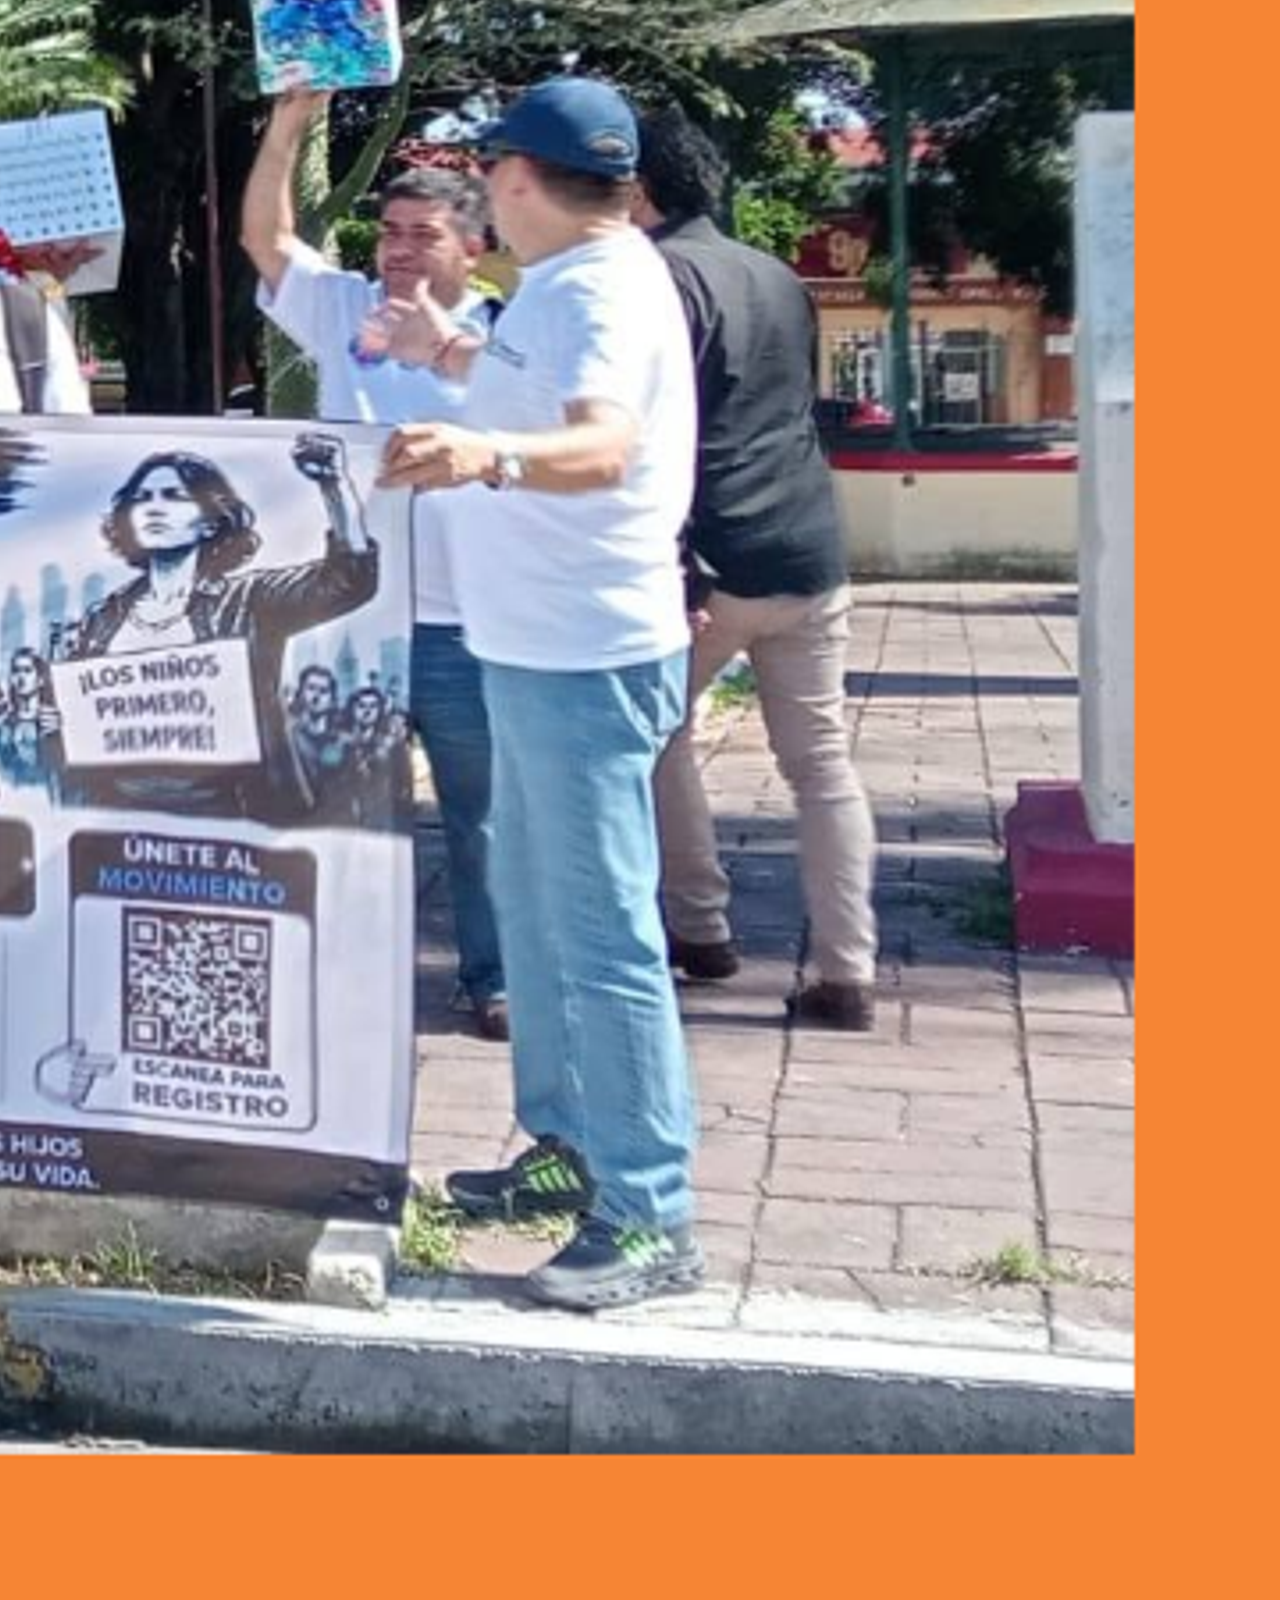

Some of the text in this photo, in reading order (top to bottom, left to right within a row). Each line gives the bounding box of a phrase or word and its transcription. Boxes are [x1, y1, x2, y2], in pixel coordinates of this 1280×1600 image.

[79, 653, 221, 695] ¡LOS NIÑOS
[95, 689, 216, 720] PRIMERO,
[102, 724, 217, 754] SIEMPRE!
[123, 834, 261, 875] ÚNETE AL
[98, 867, 286, 905] MOVIMIENTO
[132, 1058, 286, 1092] ESCANEA PARA
[132, 1080, 289, 1119] REGISTRO
[9, 1132, 84, 1159] HIJOS
[32, 1164, 101, 1190] VIDA.
